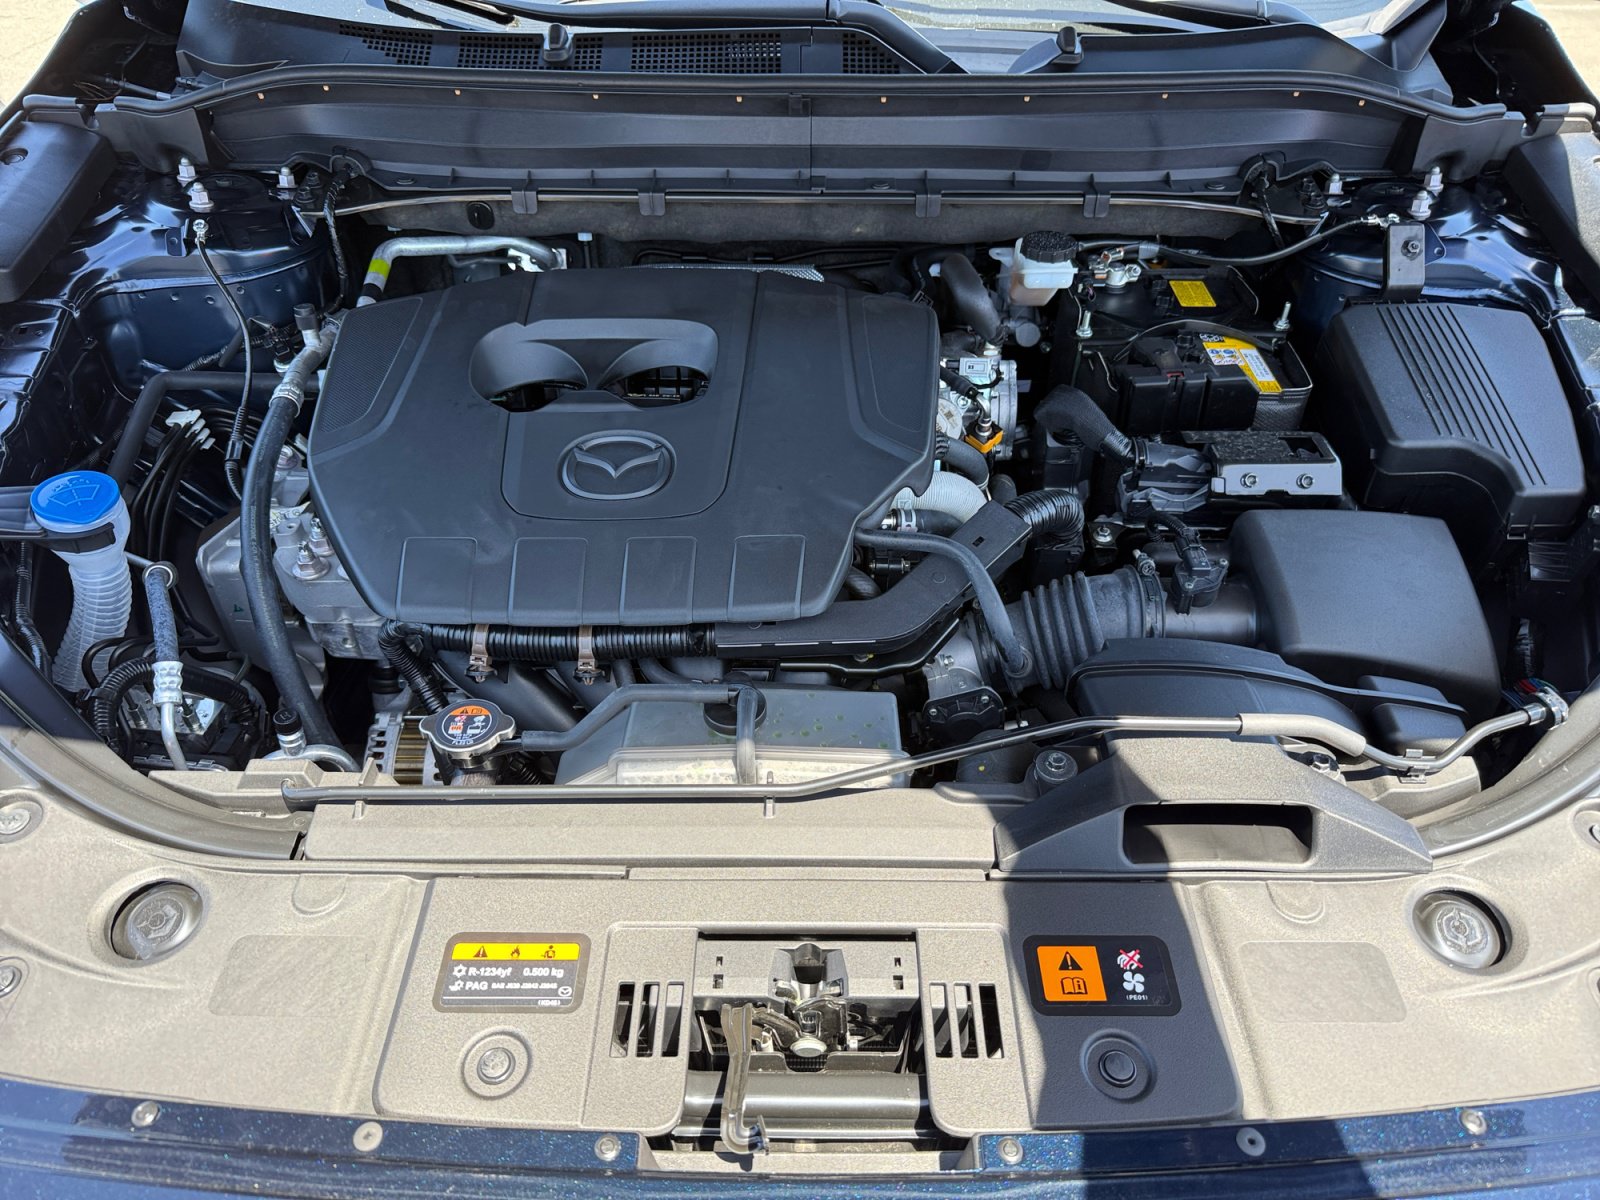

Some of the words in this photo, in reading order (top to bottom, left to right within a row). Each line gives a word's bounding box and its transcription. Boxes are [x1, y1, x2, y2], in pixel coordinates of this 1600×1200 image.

[468, 967, 512, 978] R-1234yf
[523, 967, 549, 977] 0.500
[551, 968, 564, 978] kg
[465, 981, 488, 991] PAG
